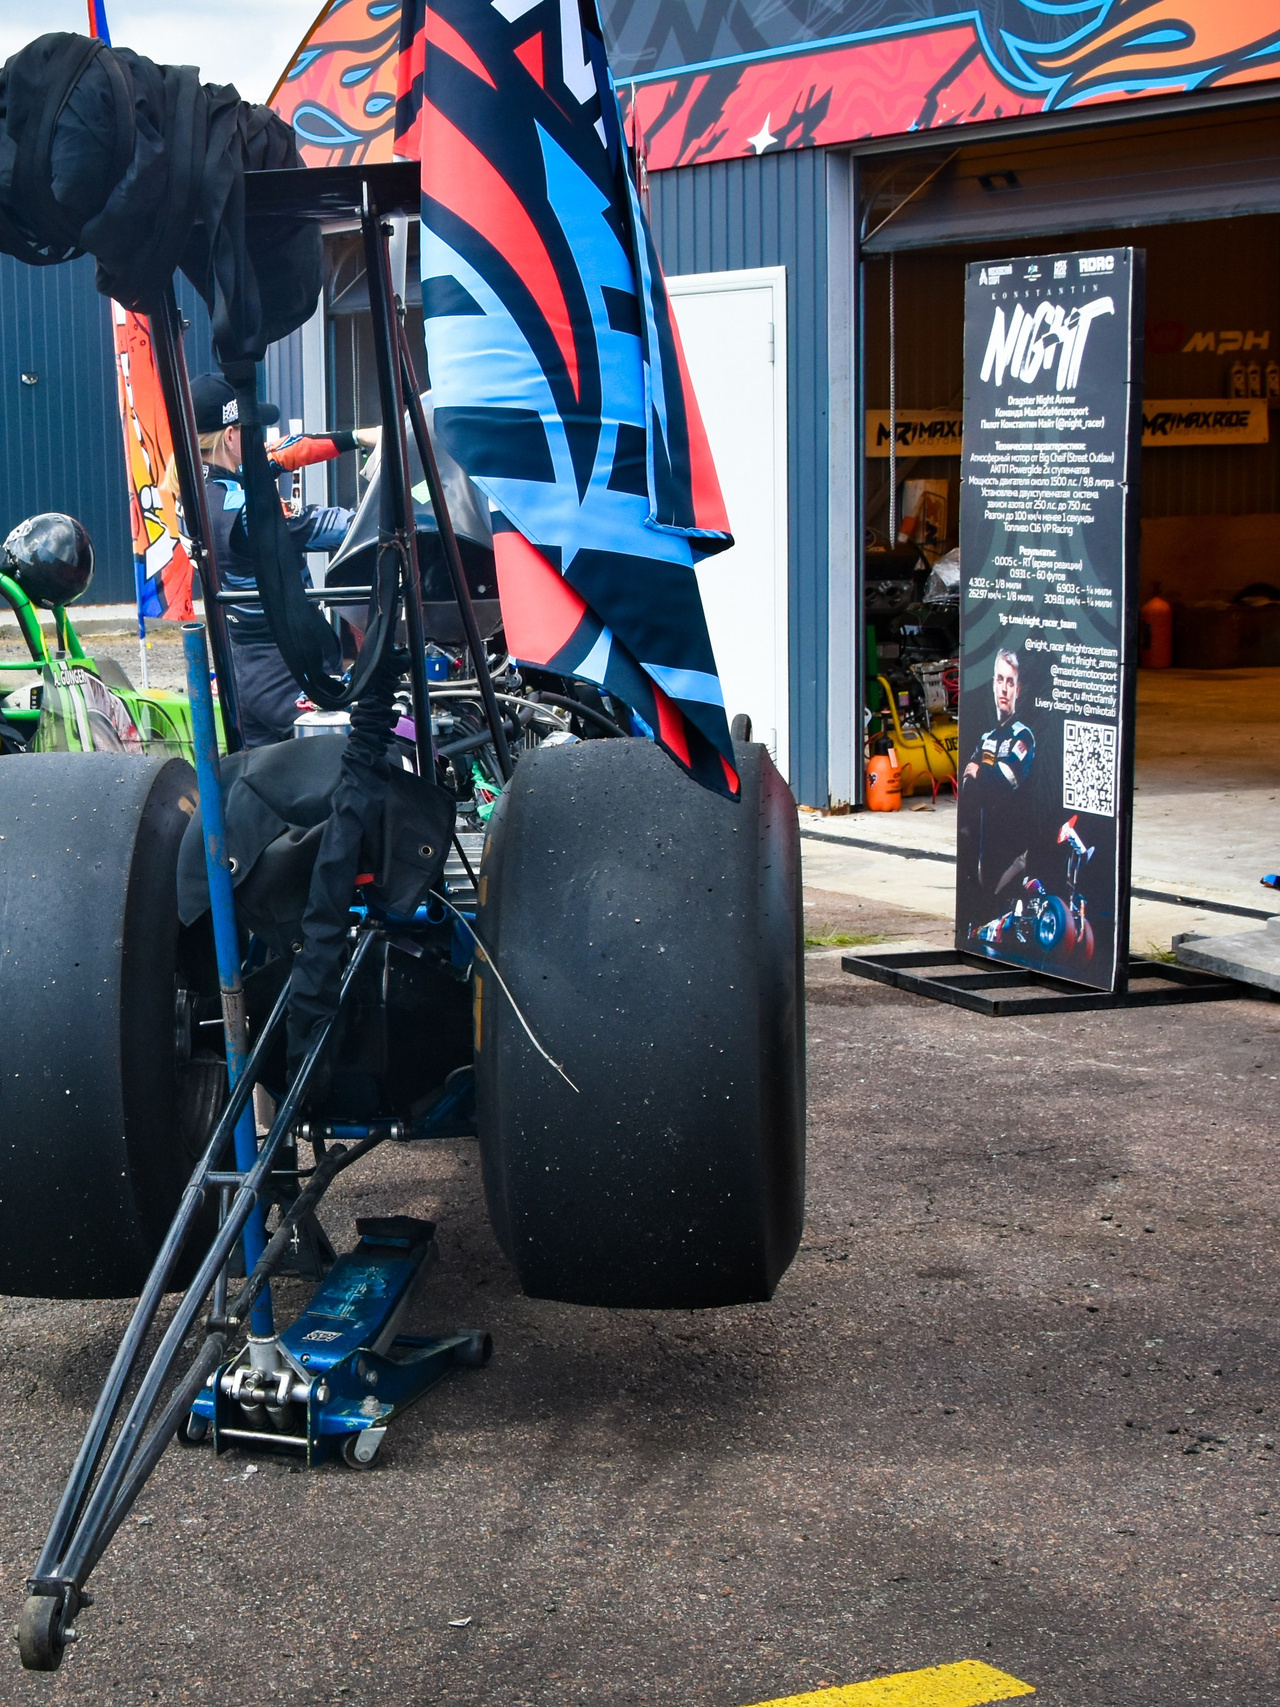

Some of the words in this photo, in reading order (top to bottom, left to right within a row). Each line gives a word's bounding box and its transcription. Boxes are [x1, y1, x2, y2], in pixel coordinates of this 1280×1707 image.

[991, 284, 1098, 300] KONSTANTIN
[980, 296, 1115, 392] NIGHT
[1008, 396, 1035, 407] Dragster
[1036, 395, 1054, 406] Night
[1055, 395, 1076, 404] Arrow
[1024, 406, 1089, 418] MaxRideMotorsport
[1050, 477, 1067, 486] 1500
[1034, 500, 1046, 509] 250
[1068, 501, 1080, 510] 750
[1052, 524, 1073, 536] Racing
[1025, 638, 1064, 652] @night_racer
[1035, 697, 1053, 710] Livery
[1054, 702, 1074, 713] design
[1074, 702, 1083, 715] by
